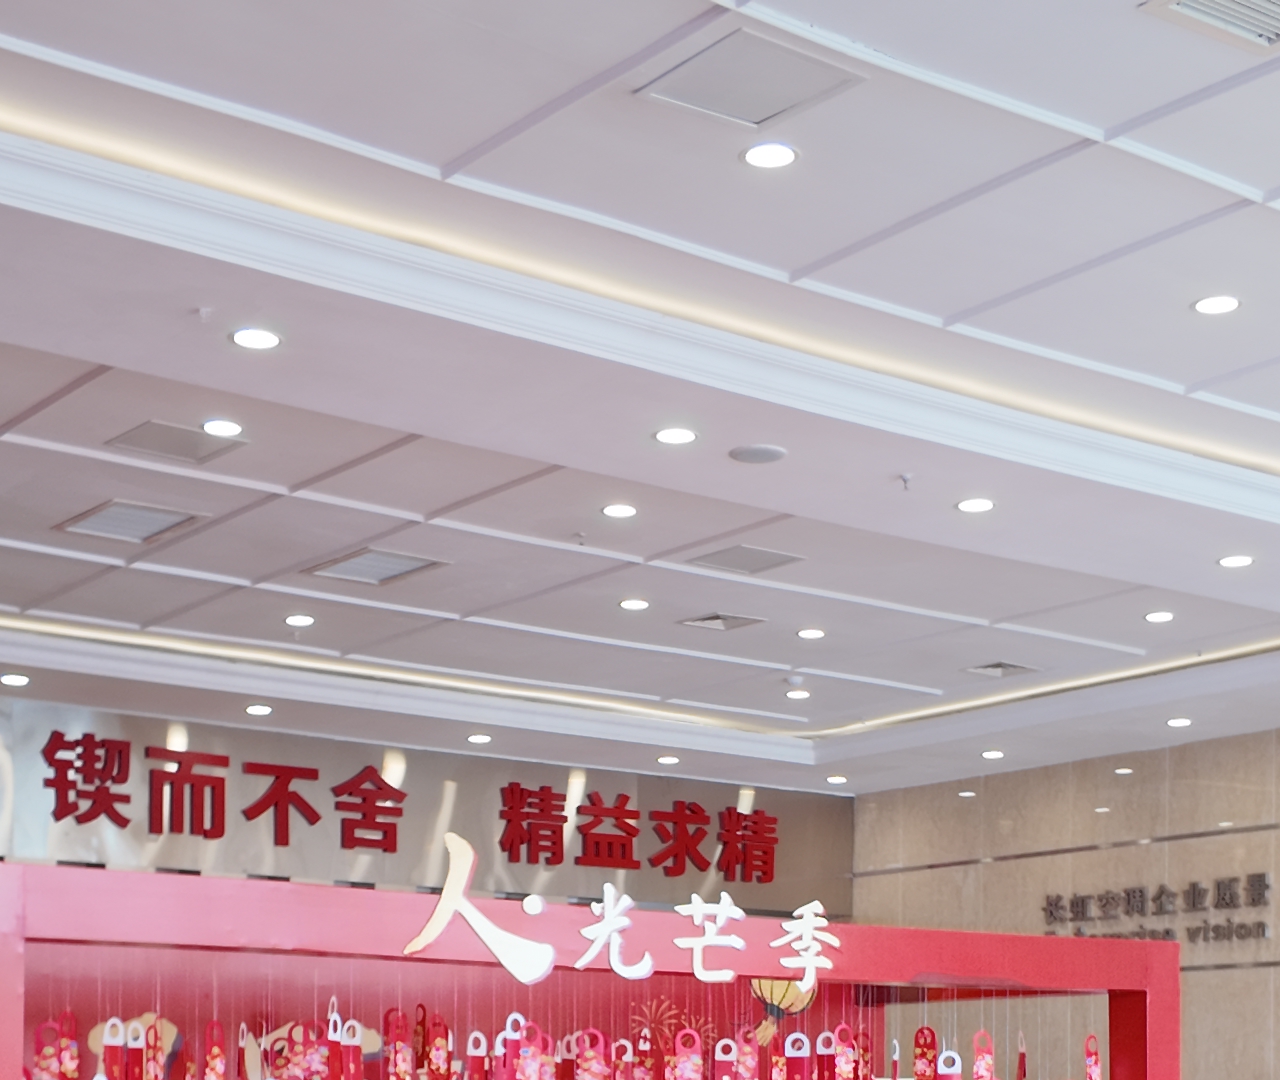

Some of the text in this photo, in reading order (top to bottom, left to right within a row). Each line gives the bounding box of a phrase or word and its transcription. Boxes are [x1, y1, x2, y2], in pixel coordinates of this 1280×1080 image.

[42, 730, 407, 853] 锲而不舍
[499, 782, 781, 884] 精益求精
[1186, 918, 1270, 944] vision
